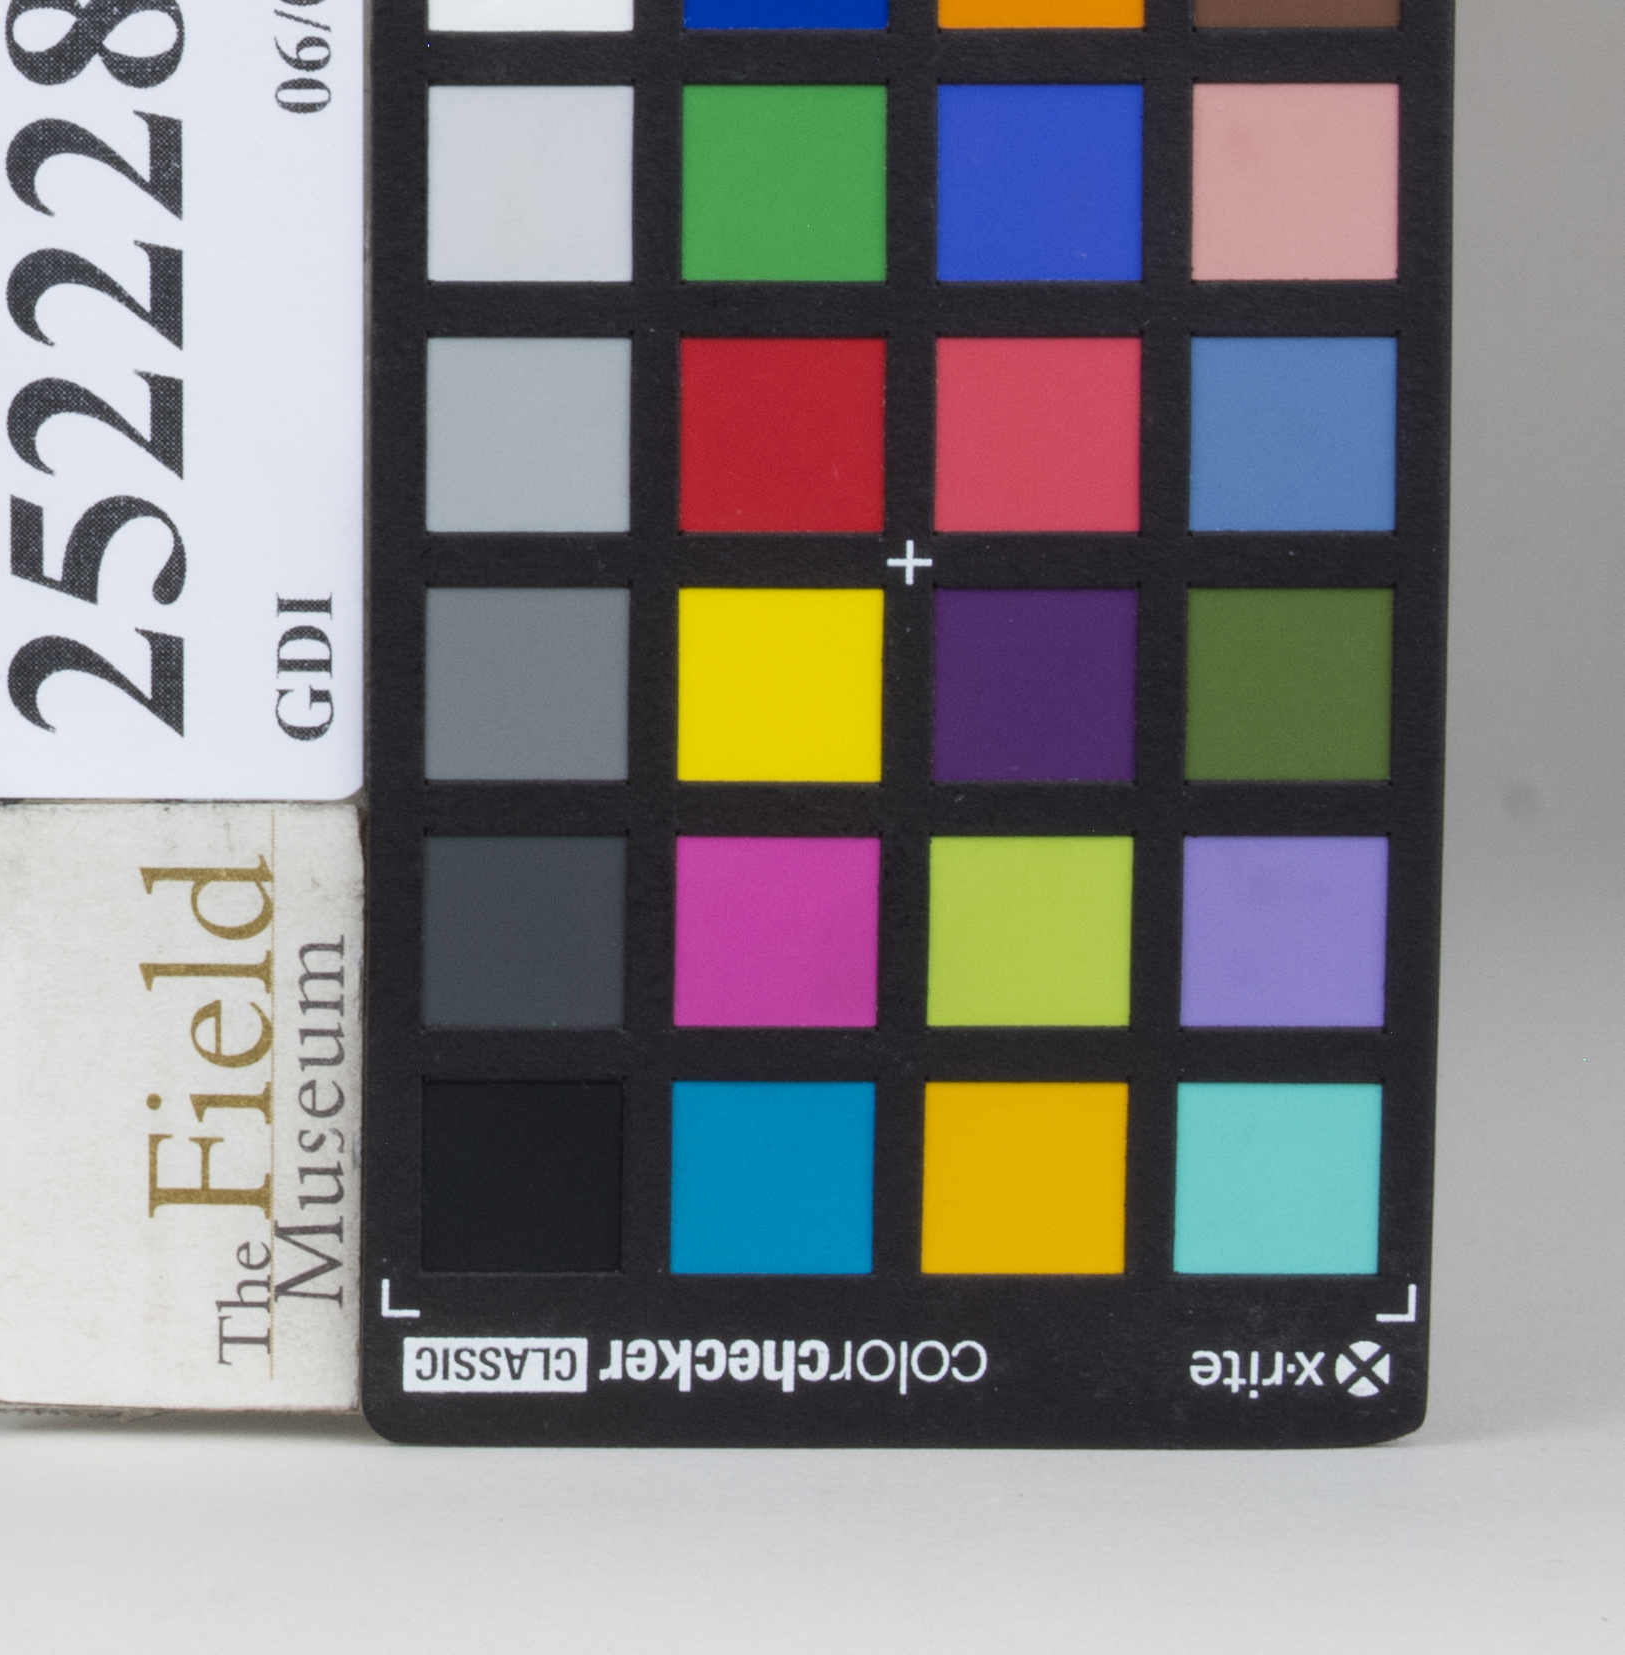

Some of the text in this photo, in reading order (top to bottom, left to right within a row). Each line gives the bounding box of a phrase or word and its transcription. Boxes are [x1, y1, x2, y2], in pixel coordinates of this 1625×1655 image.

[274, 591, 335, 742] GDI
[138, 853, 275, 1366] The Field
[273, 933, 346, 1307] Museum
[414, 1338, 989, 1396] colorchecker CLASSIC
